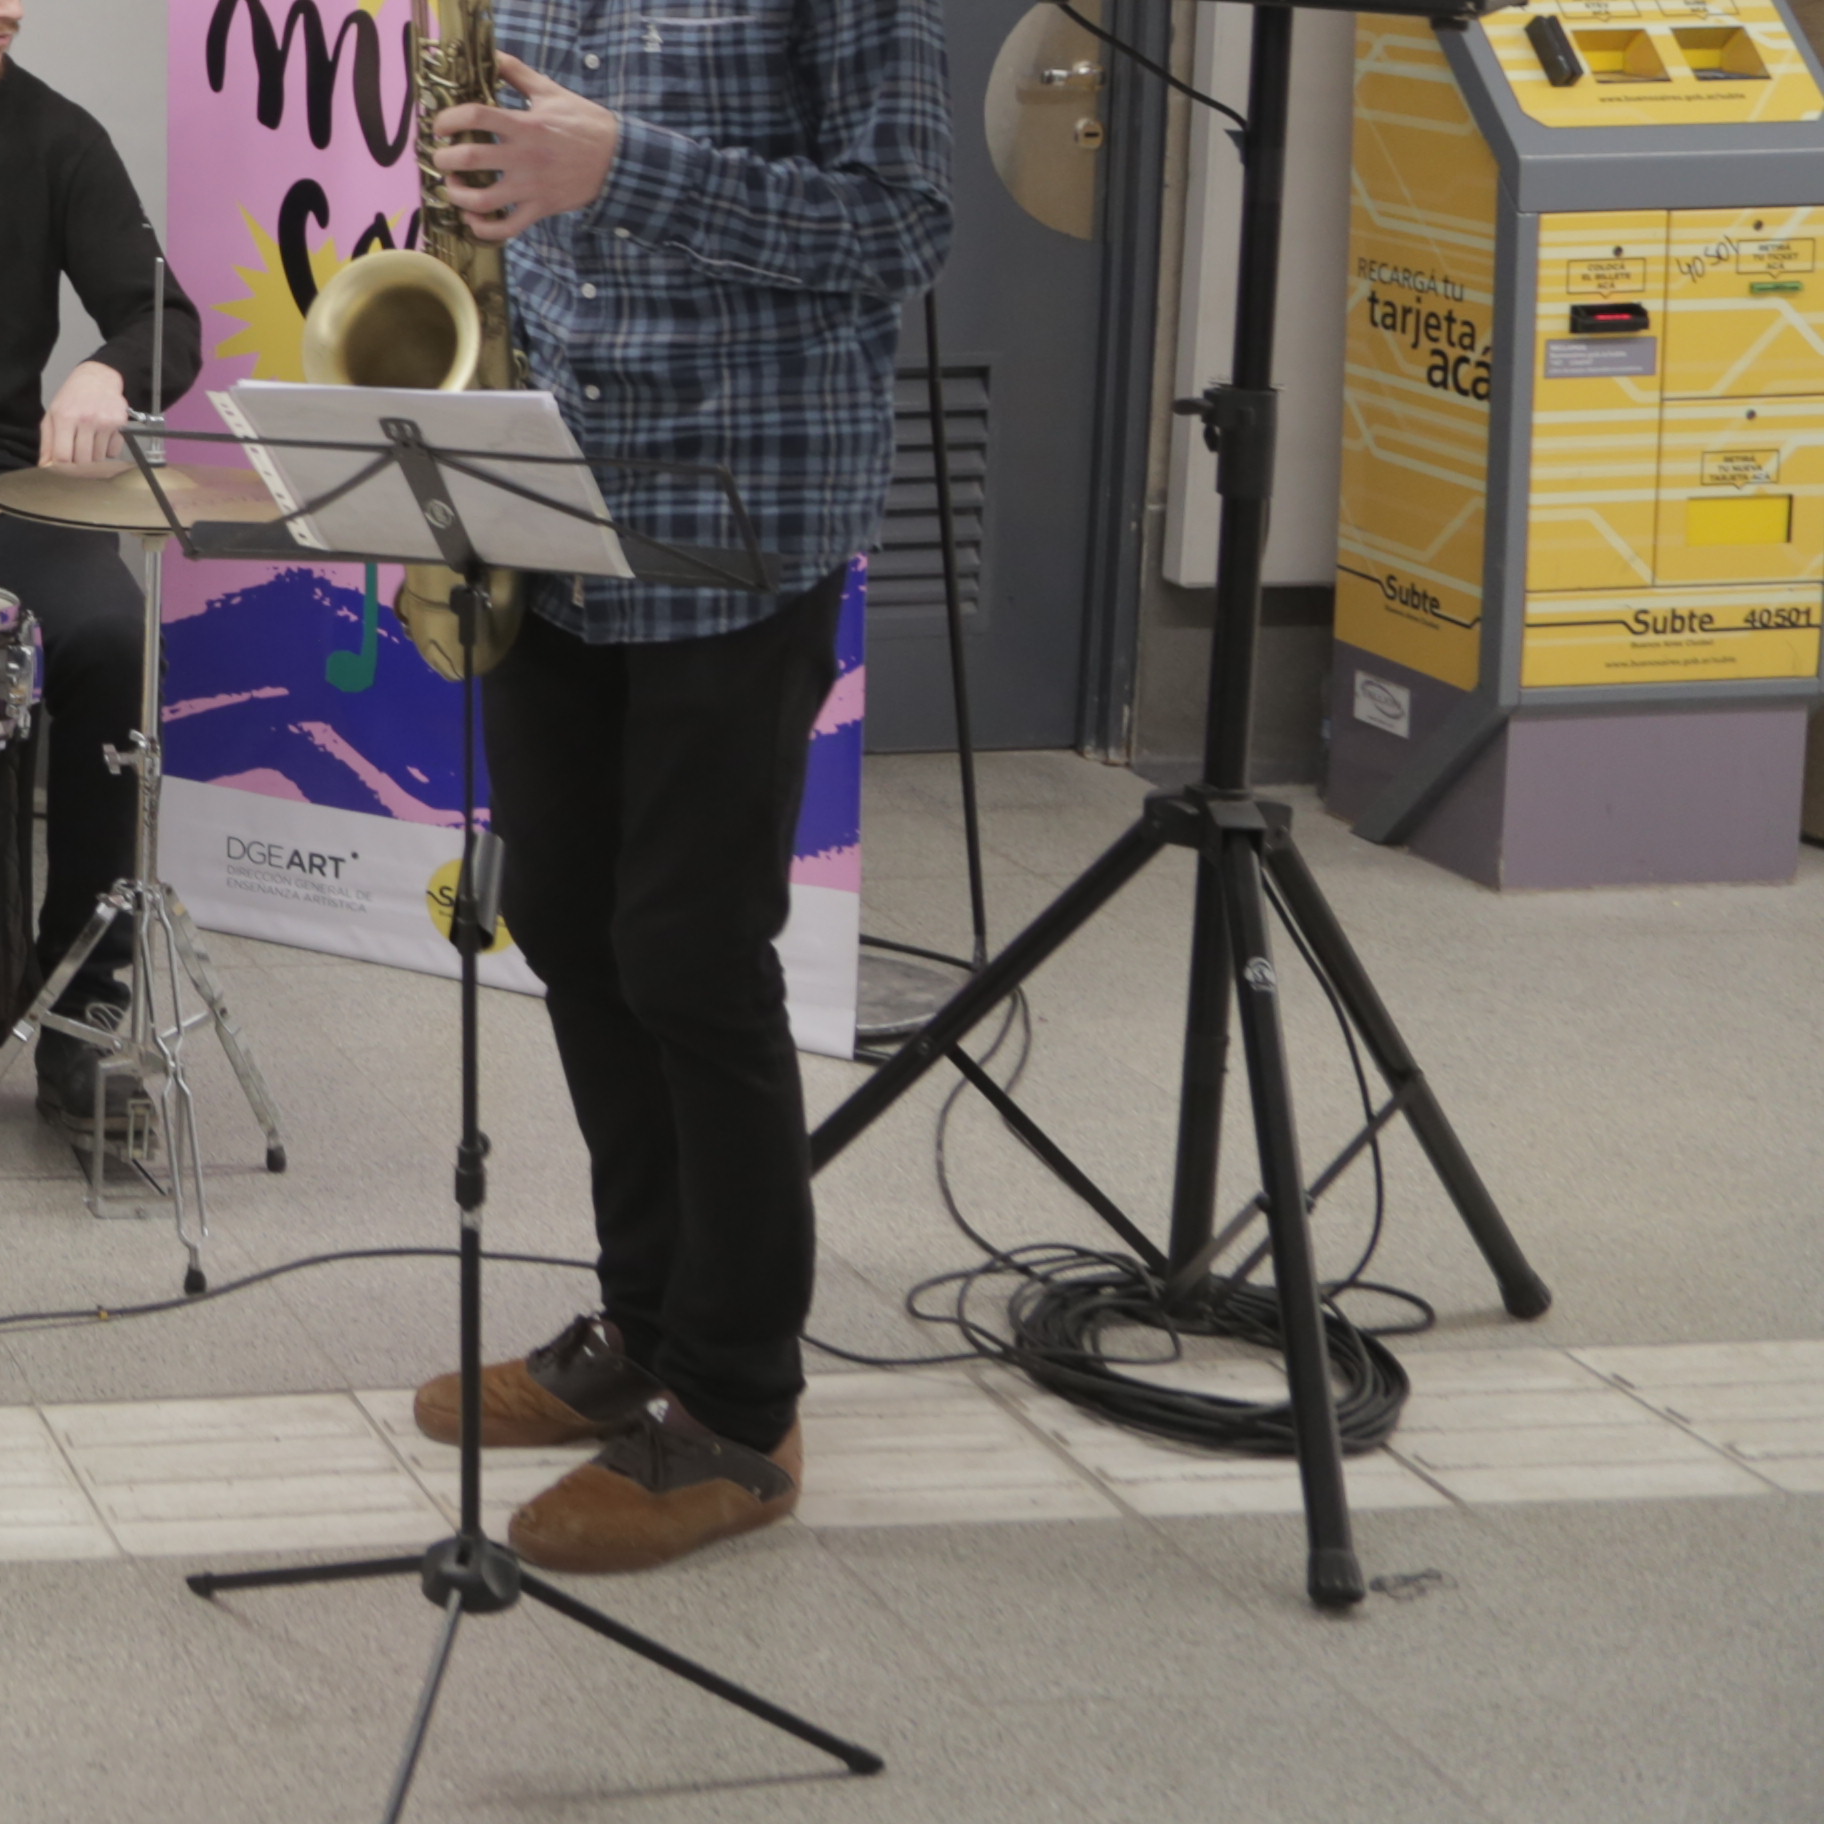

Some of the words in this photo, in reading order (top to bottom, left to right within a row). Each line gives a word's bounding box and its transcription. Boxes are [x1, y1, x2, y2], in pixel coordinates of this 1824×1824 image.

[1357, 257, 1438, 297] RECARGÁ
[1441, 274, 1464, 303] tu
[1366, 290, 1476, 353] tarjeta
[1426, 345, 1492, 401] acá
[1382, 573, 1441, 615] Subte
[1629, 608, 1715, 636] Subte
[1742, 606, 1812, 628] 40501
[227, 836, 346, 880] DGEART
[295, 875, 351, 898] GENERAL
[356, 888, 372, 902] DE
